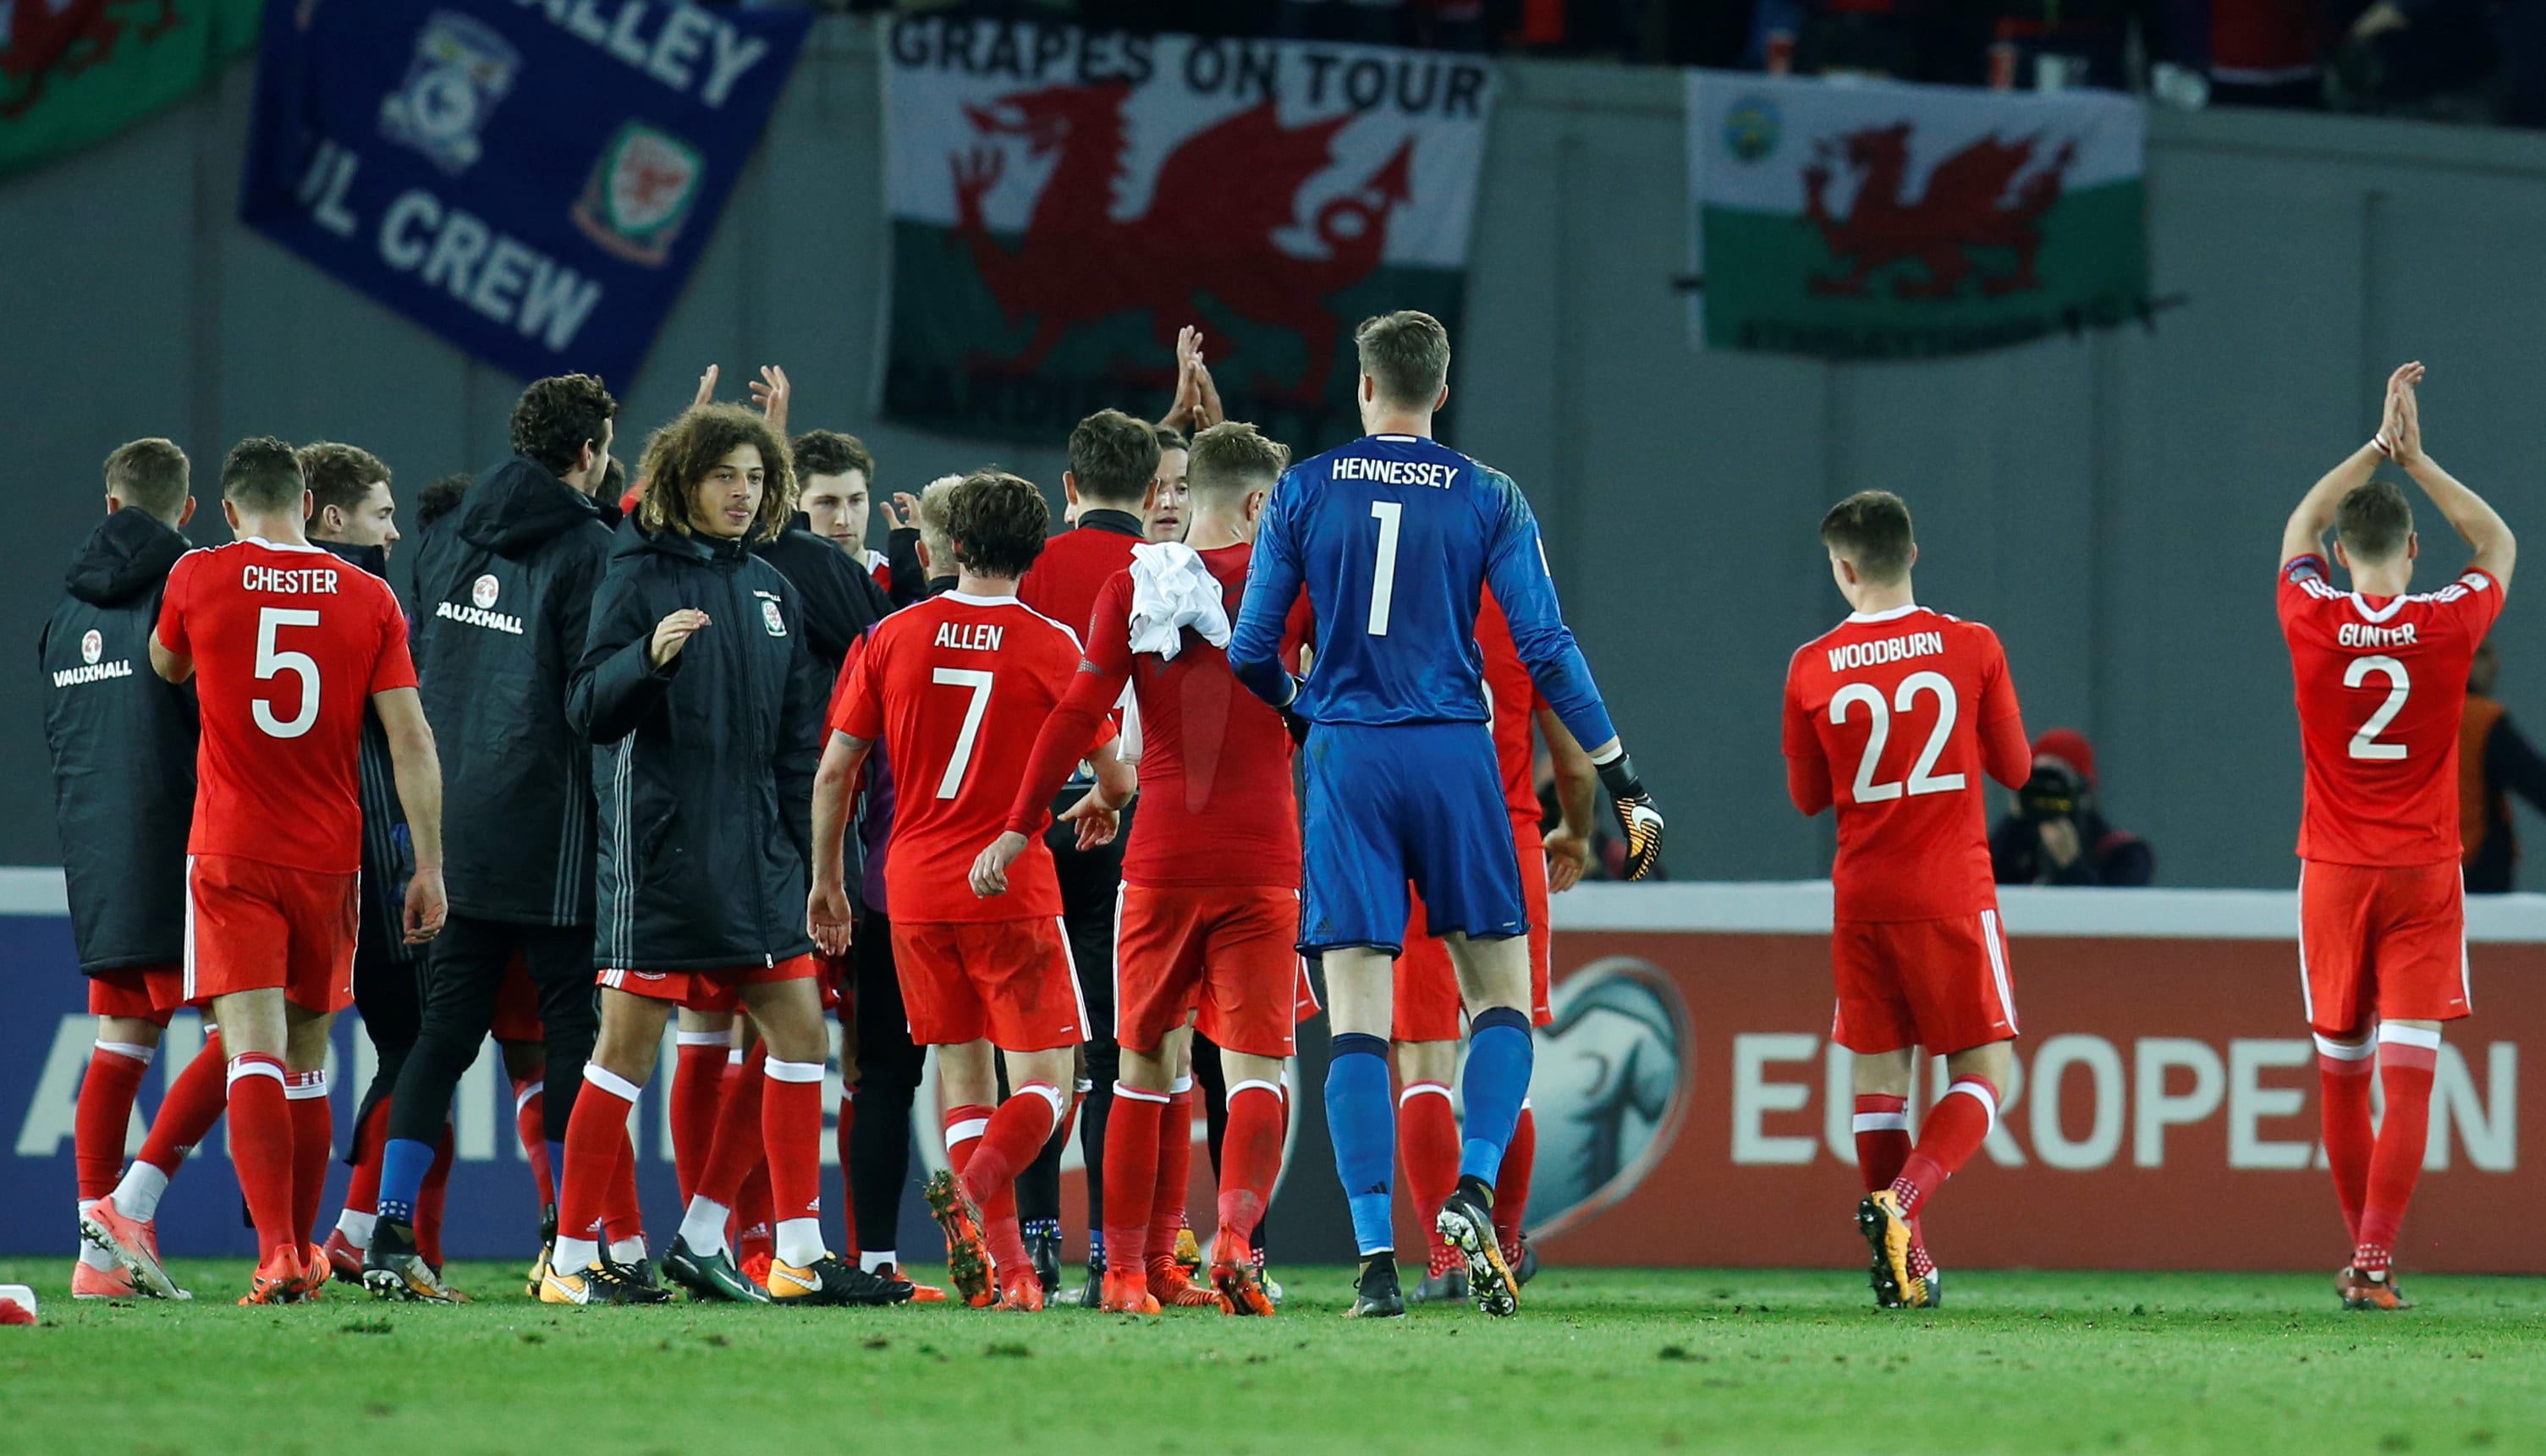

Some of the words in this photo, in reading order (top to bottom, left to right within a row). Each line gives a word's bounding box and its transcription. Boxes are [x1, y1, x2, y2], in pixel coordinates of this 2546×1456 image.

[890, 15, 1153, 85] GRAPES
[1186, 38, 1278, 100] ON
[1306, 53, 1487, 118] TOUR
[377, 188, 602, 353] CREW
[1332, 457, 1460, 489] HENNESSEY
[243, 564, 338, 595] CHESTER
[436, 599, 524, 635] AUXHALL
[1367, 500, 1402, 636] 1
[52, 659, 133, 688] VAUXHALL
[251, 607, 321, 739] 5
[934, 622, 1004, 651] ALLEN
[1828, 631, 1944, 672] WOODBURN
[2338, 622, 2417, 647] GUNTER
[932, 667, 994, 799] 7
[1828, 670, 1966, 803] 22
[2343, 655, 2411, 760] 2
[1731, 1031, 2518, 1173] EUROPEN
